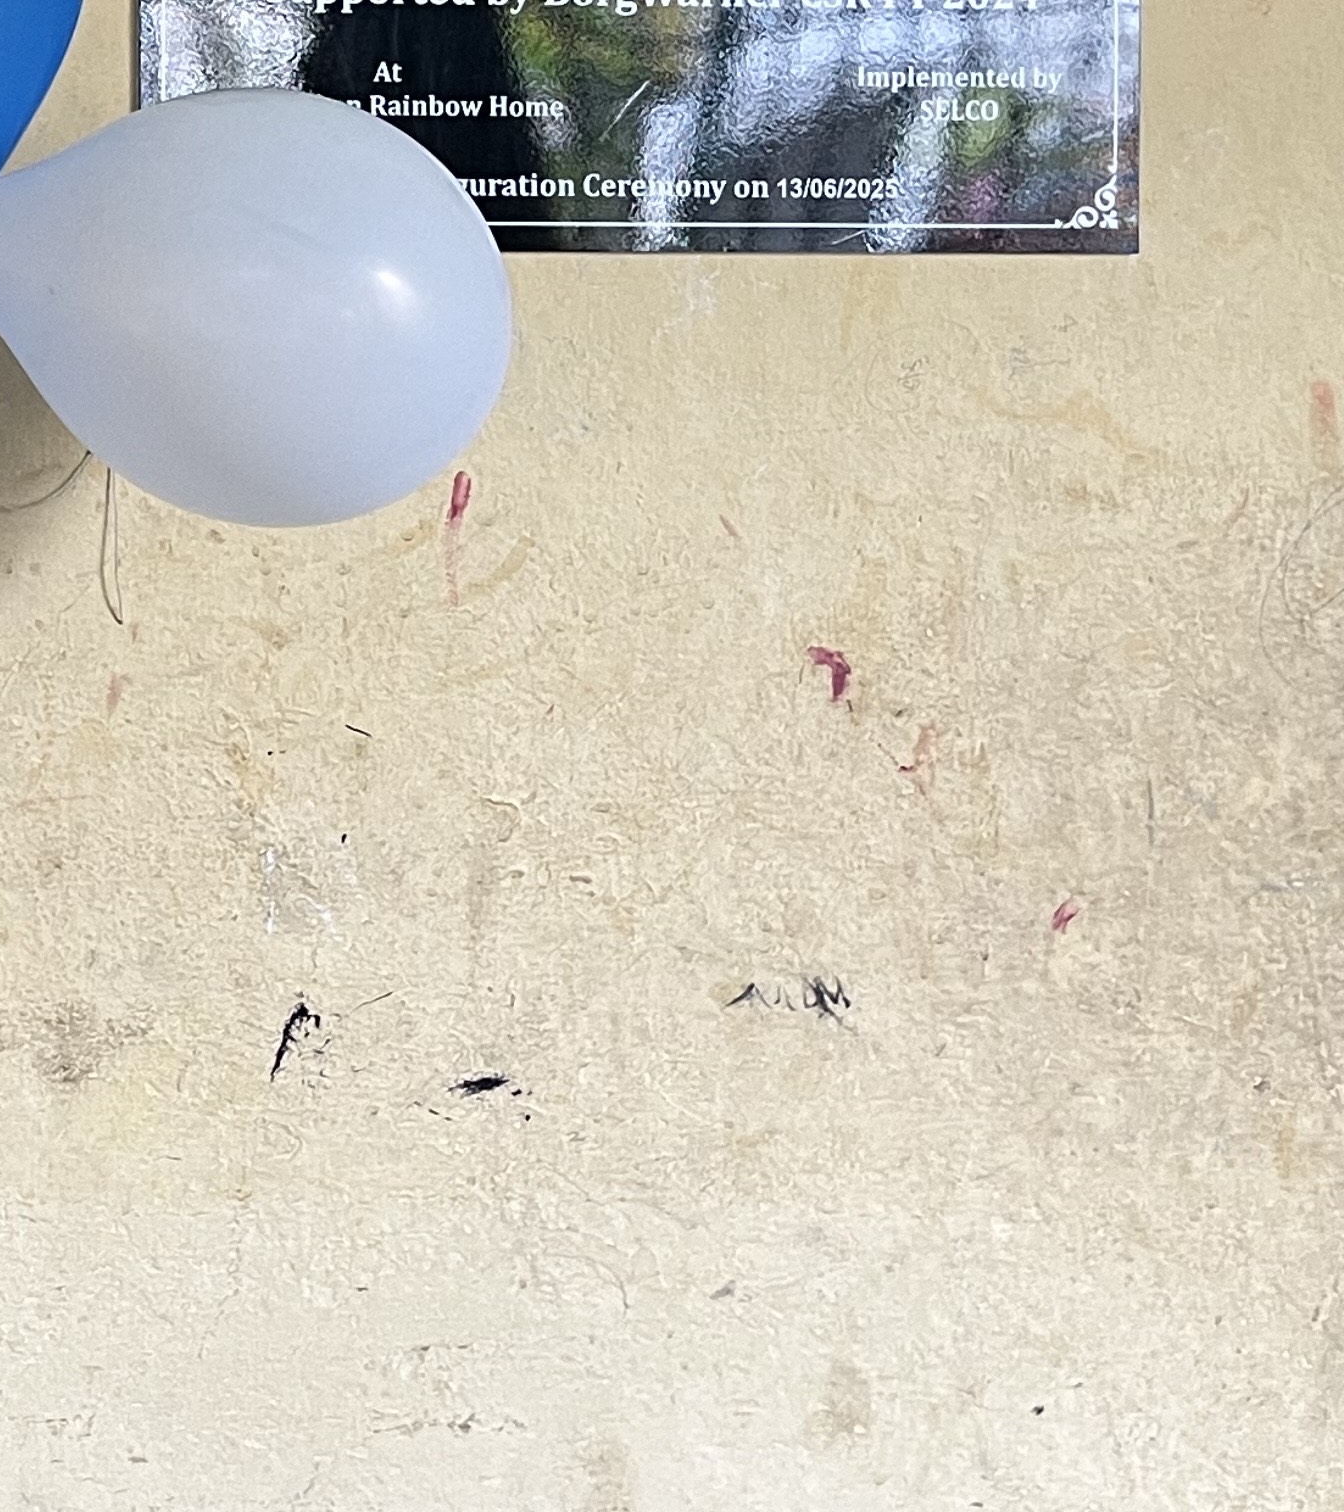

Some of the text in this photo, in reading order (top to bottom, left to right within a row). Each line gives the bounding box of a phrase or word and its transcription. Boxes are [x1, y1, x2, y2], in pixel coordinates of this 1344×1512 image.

[373, 62, 402, 82] At
[858, 66, 1062, 94] Implemented by
[370, 94, 482, 117] Rainbow
[490, 95, 564, 117] Home
[921, 100, 999, 121] SELCO
[583, 173, 726, 204] Ceremony
[734, 178, 768, 198] on
[778, 178, 898, 200] 13/06/2025
